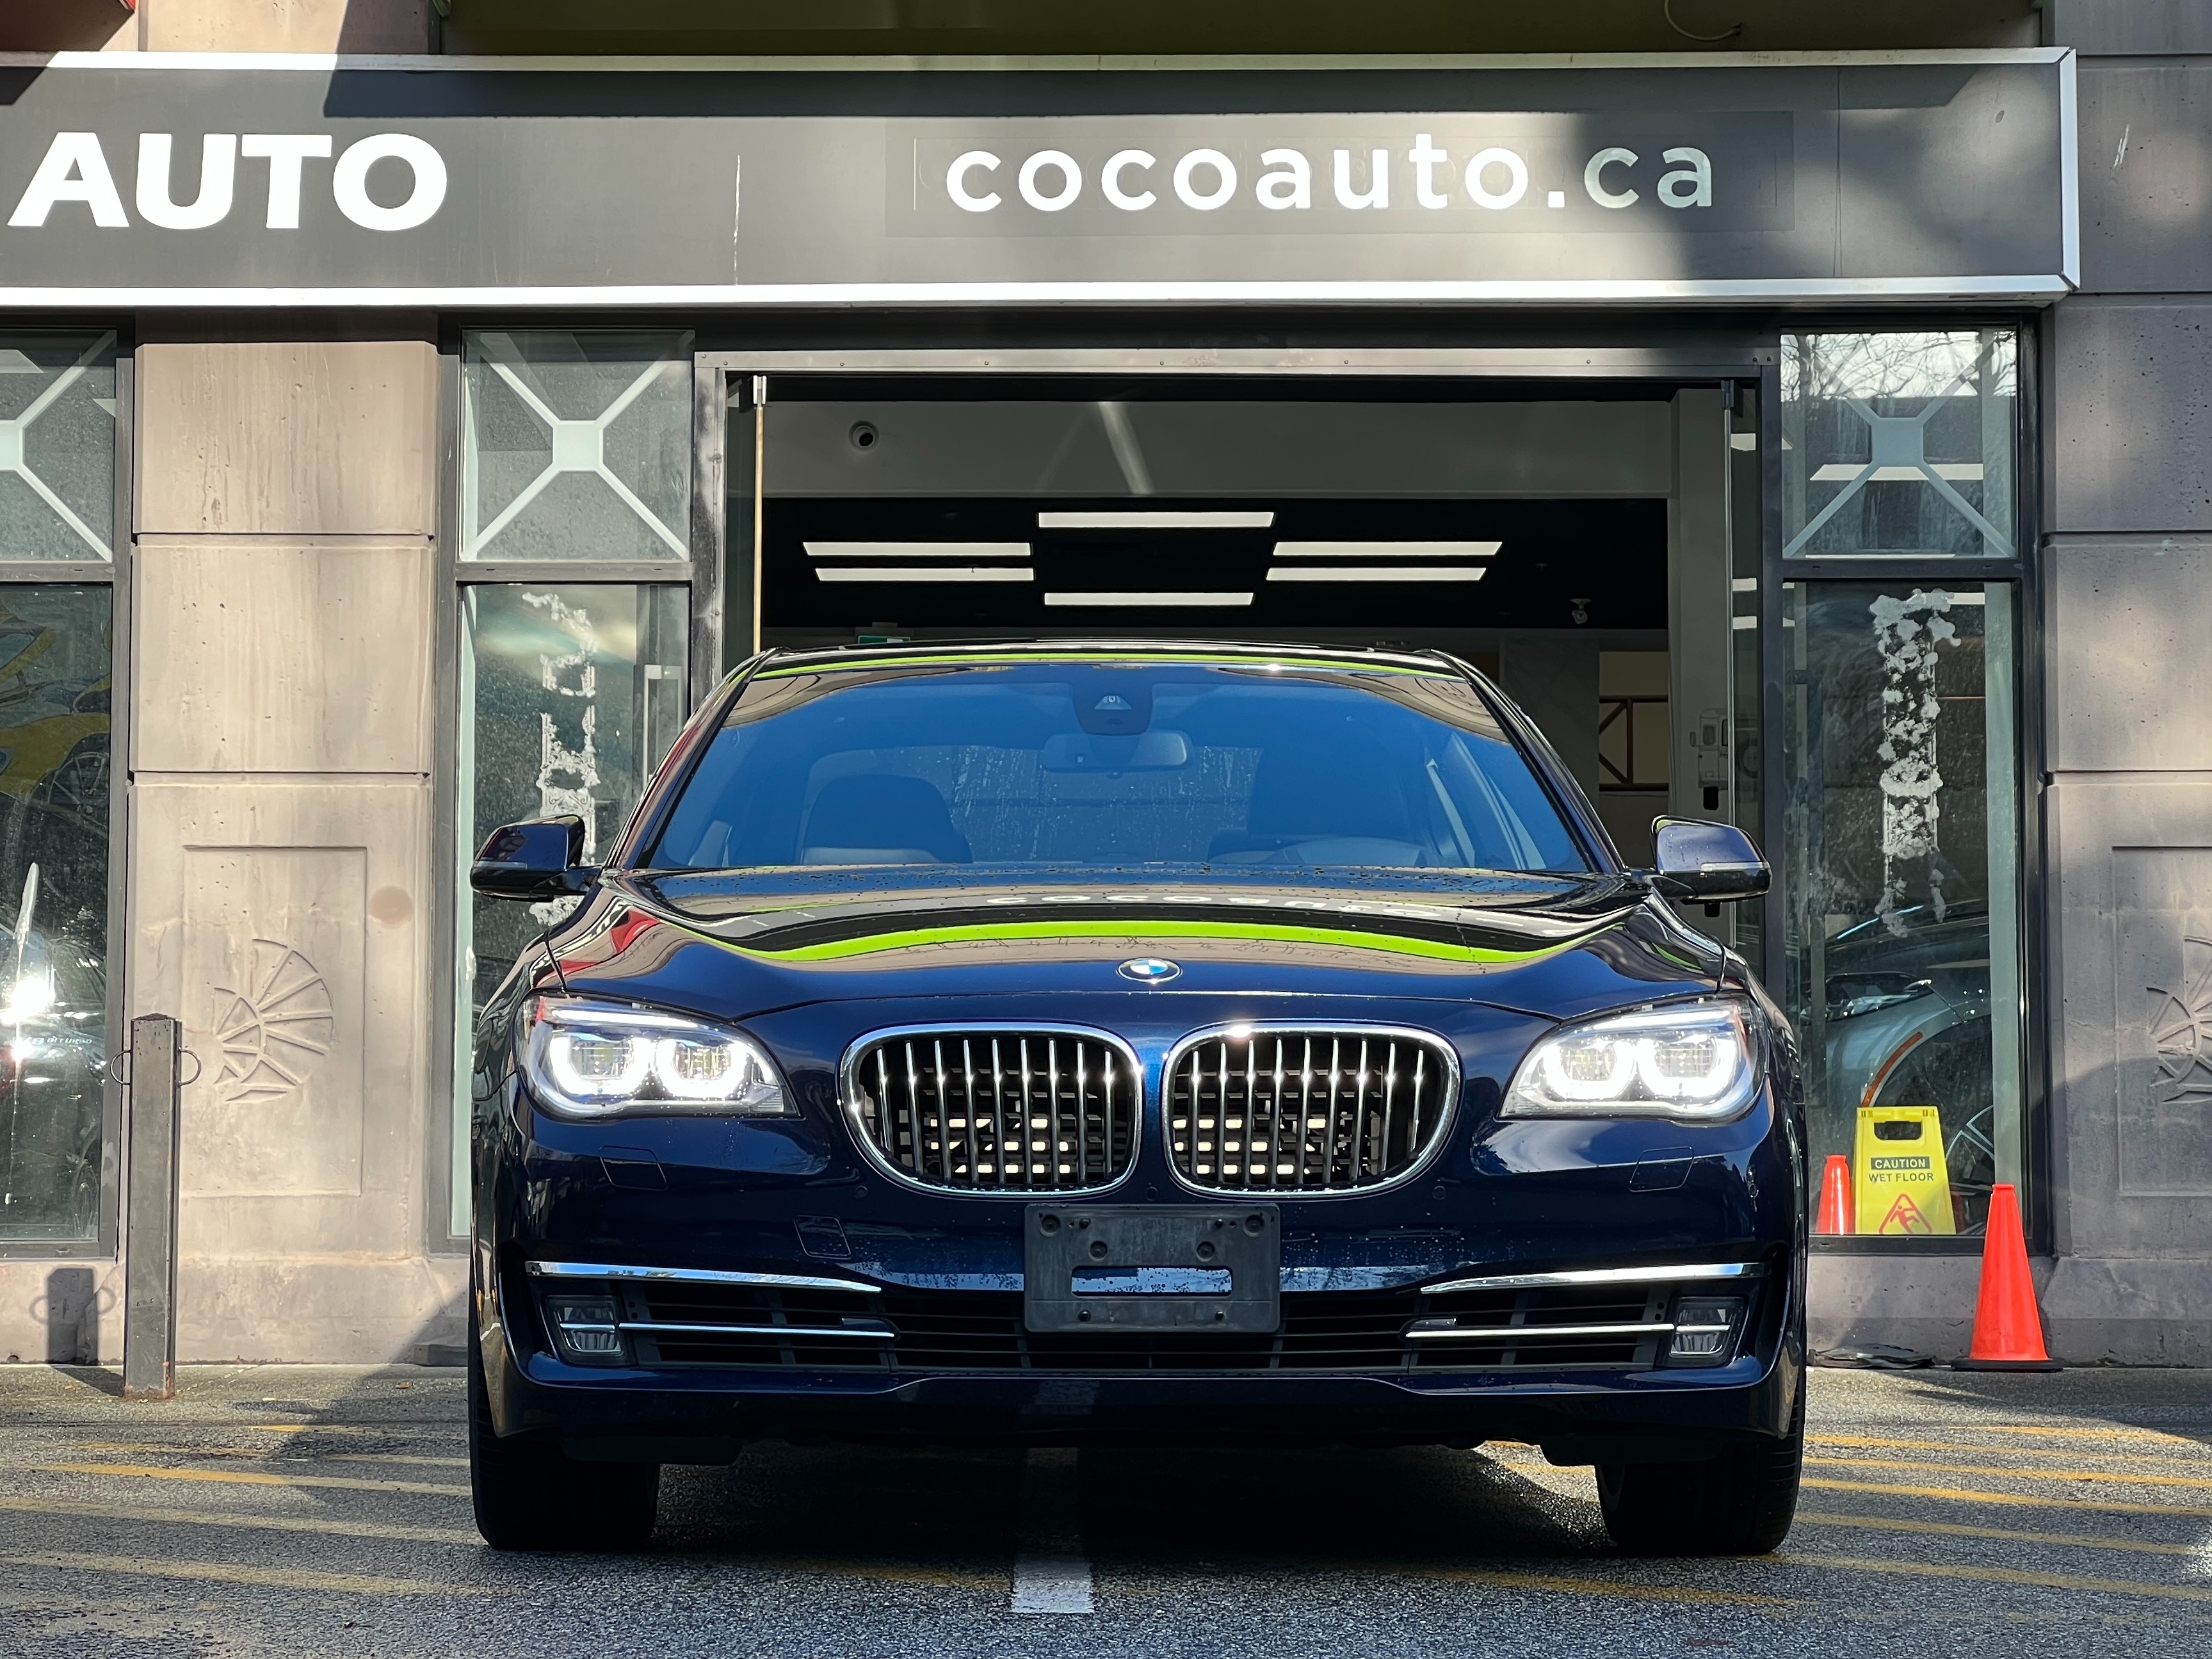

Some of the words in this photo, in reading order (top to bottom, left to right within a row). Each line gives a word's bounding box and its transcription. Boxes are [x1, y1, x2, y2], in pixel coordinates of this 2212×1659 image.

[6, 131, 448, 231] AUTO
[946, 133, 1713, 212] cocoauto.ca
[1868, 1173, 1893, 1183] WET
[1896, 1172, 1934, 1182] FLOOR
[1875, 1158, 1926, 1169] CAUTION
